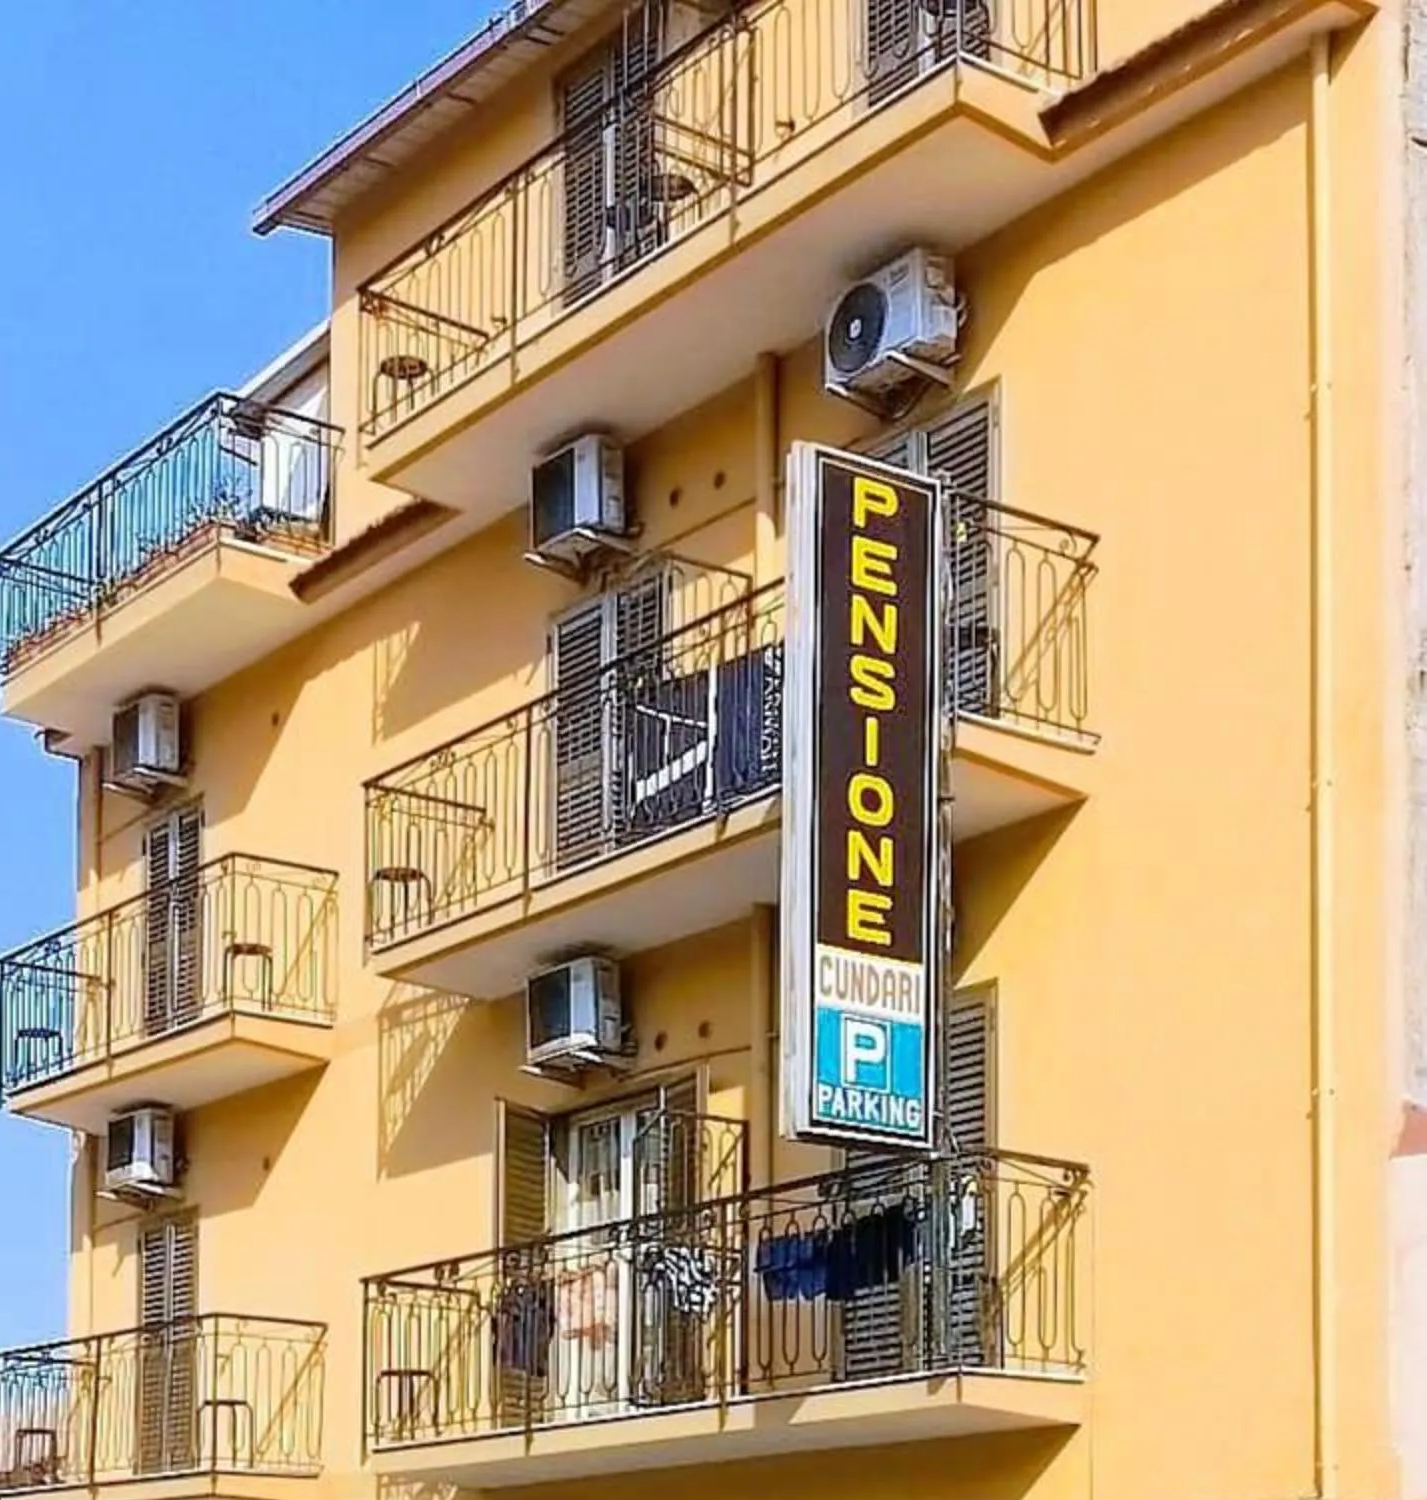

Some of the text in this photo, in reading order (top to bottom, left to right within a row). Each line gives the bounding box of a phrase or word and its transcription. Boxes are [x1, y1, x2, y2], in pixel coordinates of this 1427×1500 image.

[846, 476, 899, 947] PENSIONE
[819, 955, 921, 1014] CUNDARI
[844, 1017, 887, 1084] P
[818, 1084, 922, 1128] PARKING
